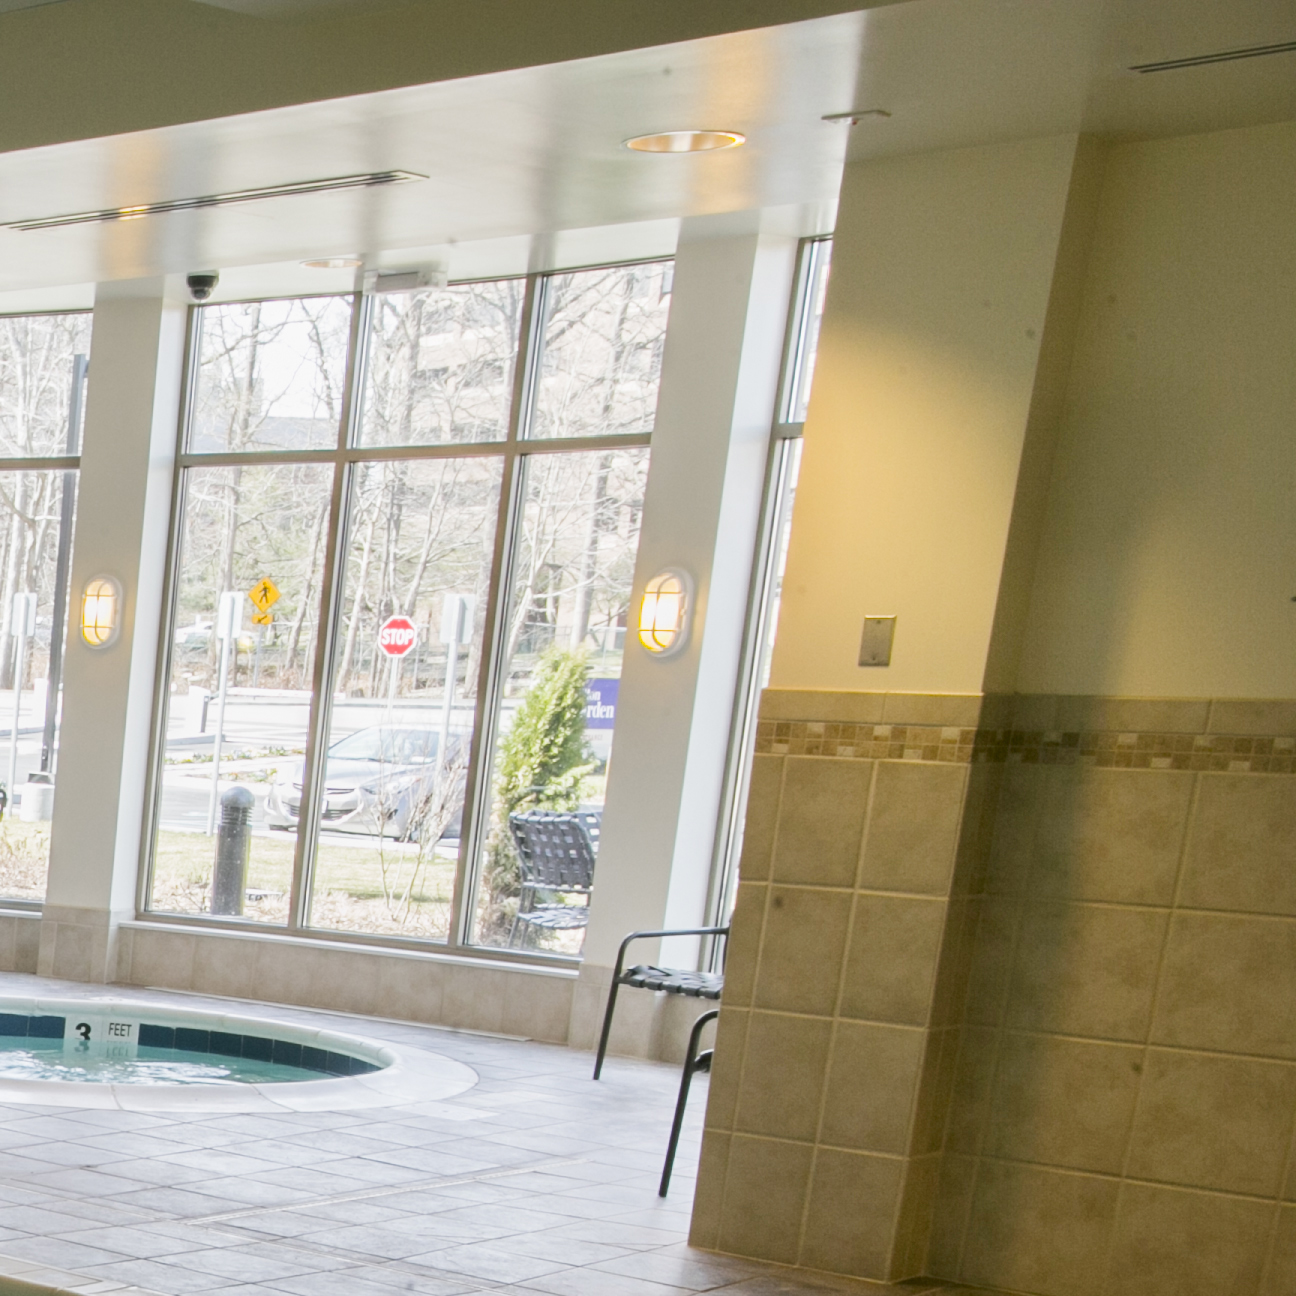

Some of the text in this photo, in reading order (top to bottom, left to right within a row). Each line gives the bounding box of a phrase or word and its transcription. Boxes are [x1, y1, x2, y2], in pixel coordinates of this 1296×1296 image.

[382, 628, 414, 646] STOP
[586, 701, 614, 718] rden
[75, 1022, 132, 1041] 3 FEET
